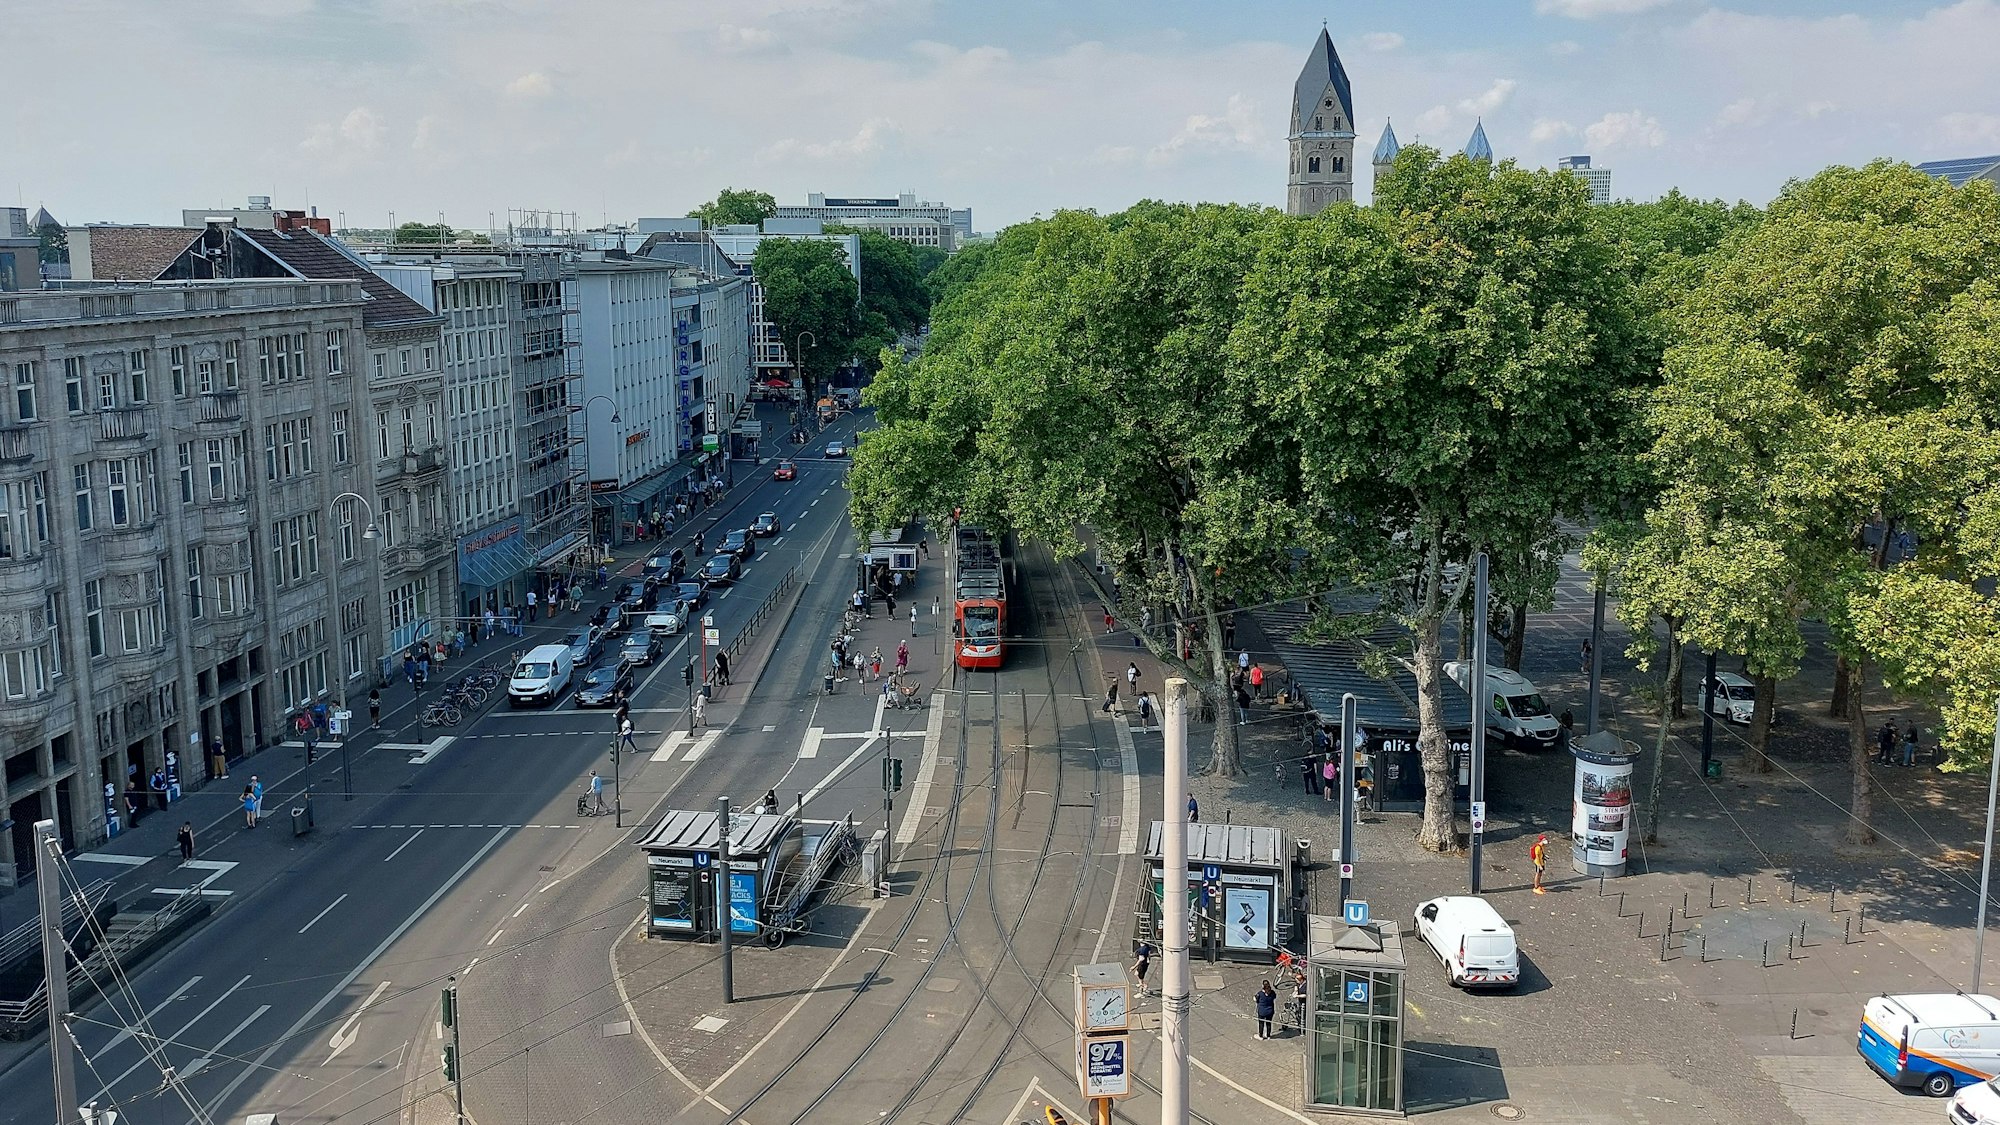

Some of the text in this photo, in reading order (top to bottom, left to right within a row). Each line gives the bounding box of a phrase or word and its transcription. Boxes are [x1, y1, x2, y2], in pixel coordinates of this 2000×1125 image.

[1383, 739, 1411, 751] Ali's
[698, 854, 707, 865] U
[1207, 867, 1217, 879] U
[1349, 906, 1364, 922] U
